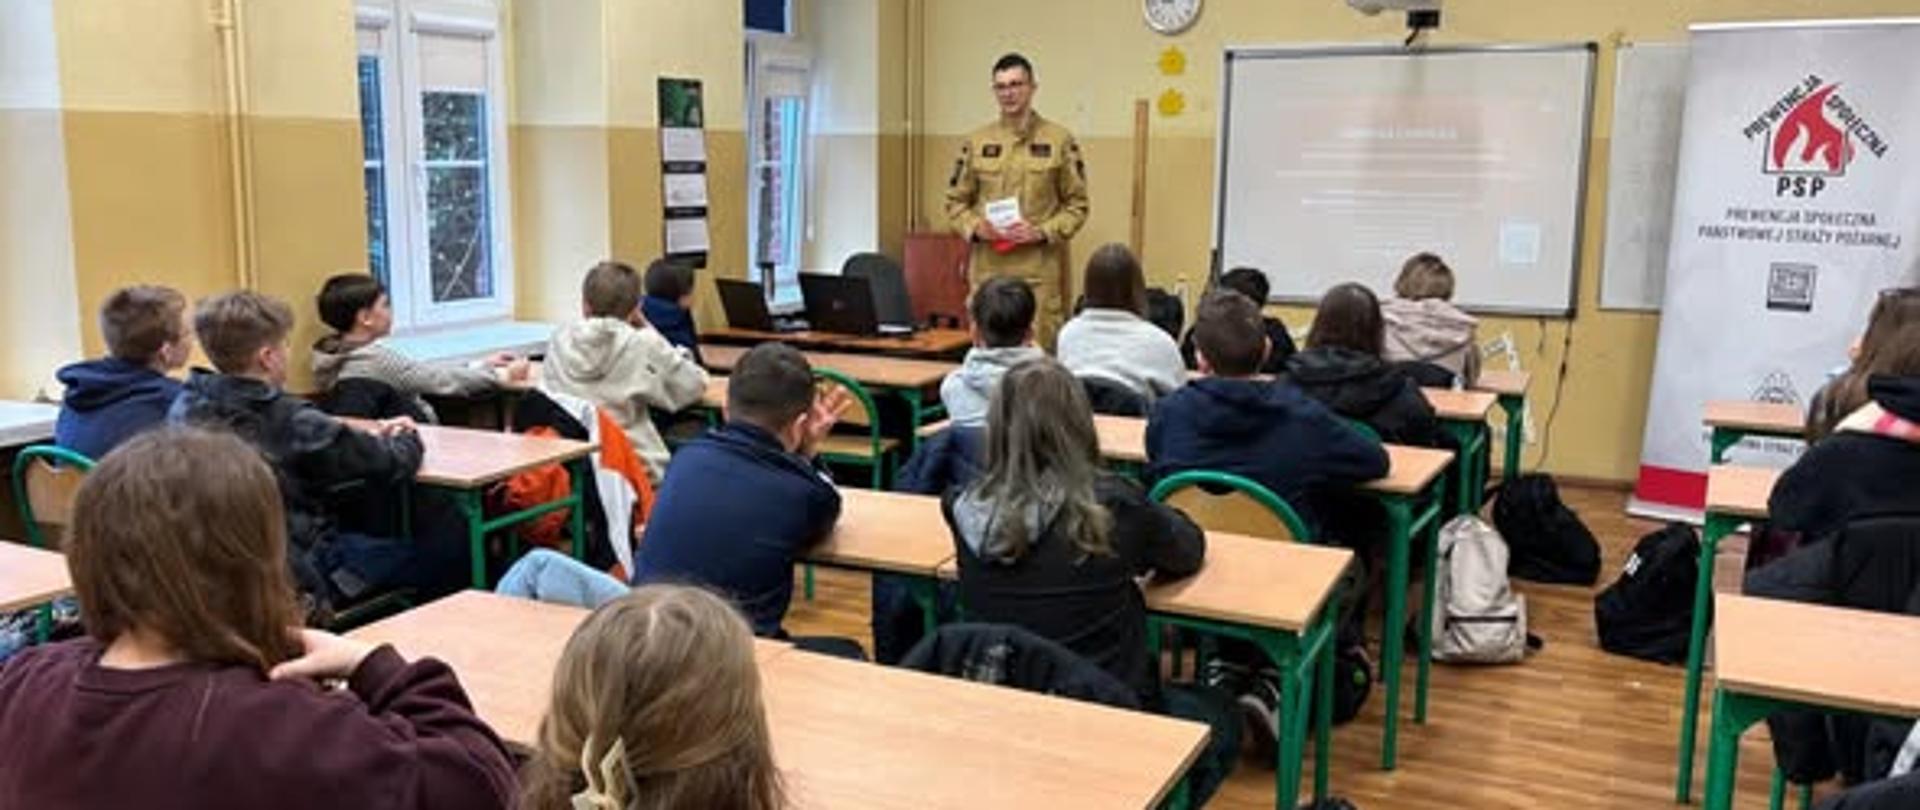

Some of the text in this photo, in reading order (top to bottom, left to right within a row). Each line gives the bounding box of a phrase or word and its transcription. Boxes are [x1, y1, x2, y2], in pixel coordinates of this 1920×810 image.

[1743, 74, 1822, 140] PREWENCJA
[1776, 176, 1825, 197] PSP
[1725, 208, 1875, 227] PREWENCJA SPOŁECZNA
[1785, 228, 1831, 243] STRAŻY
[1834, 231, 1901, 250] POŻARNEJ
